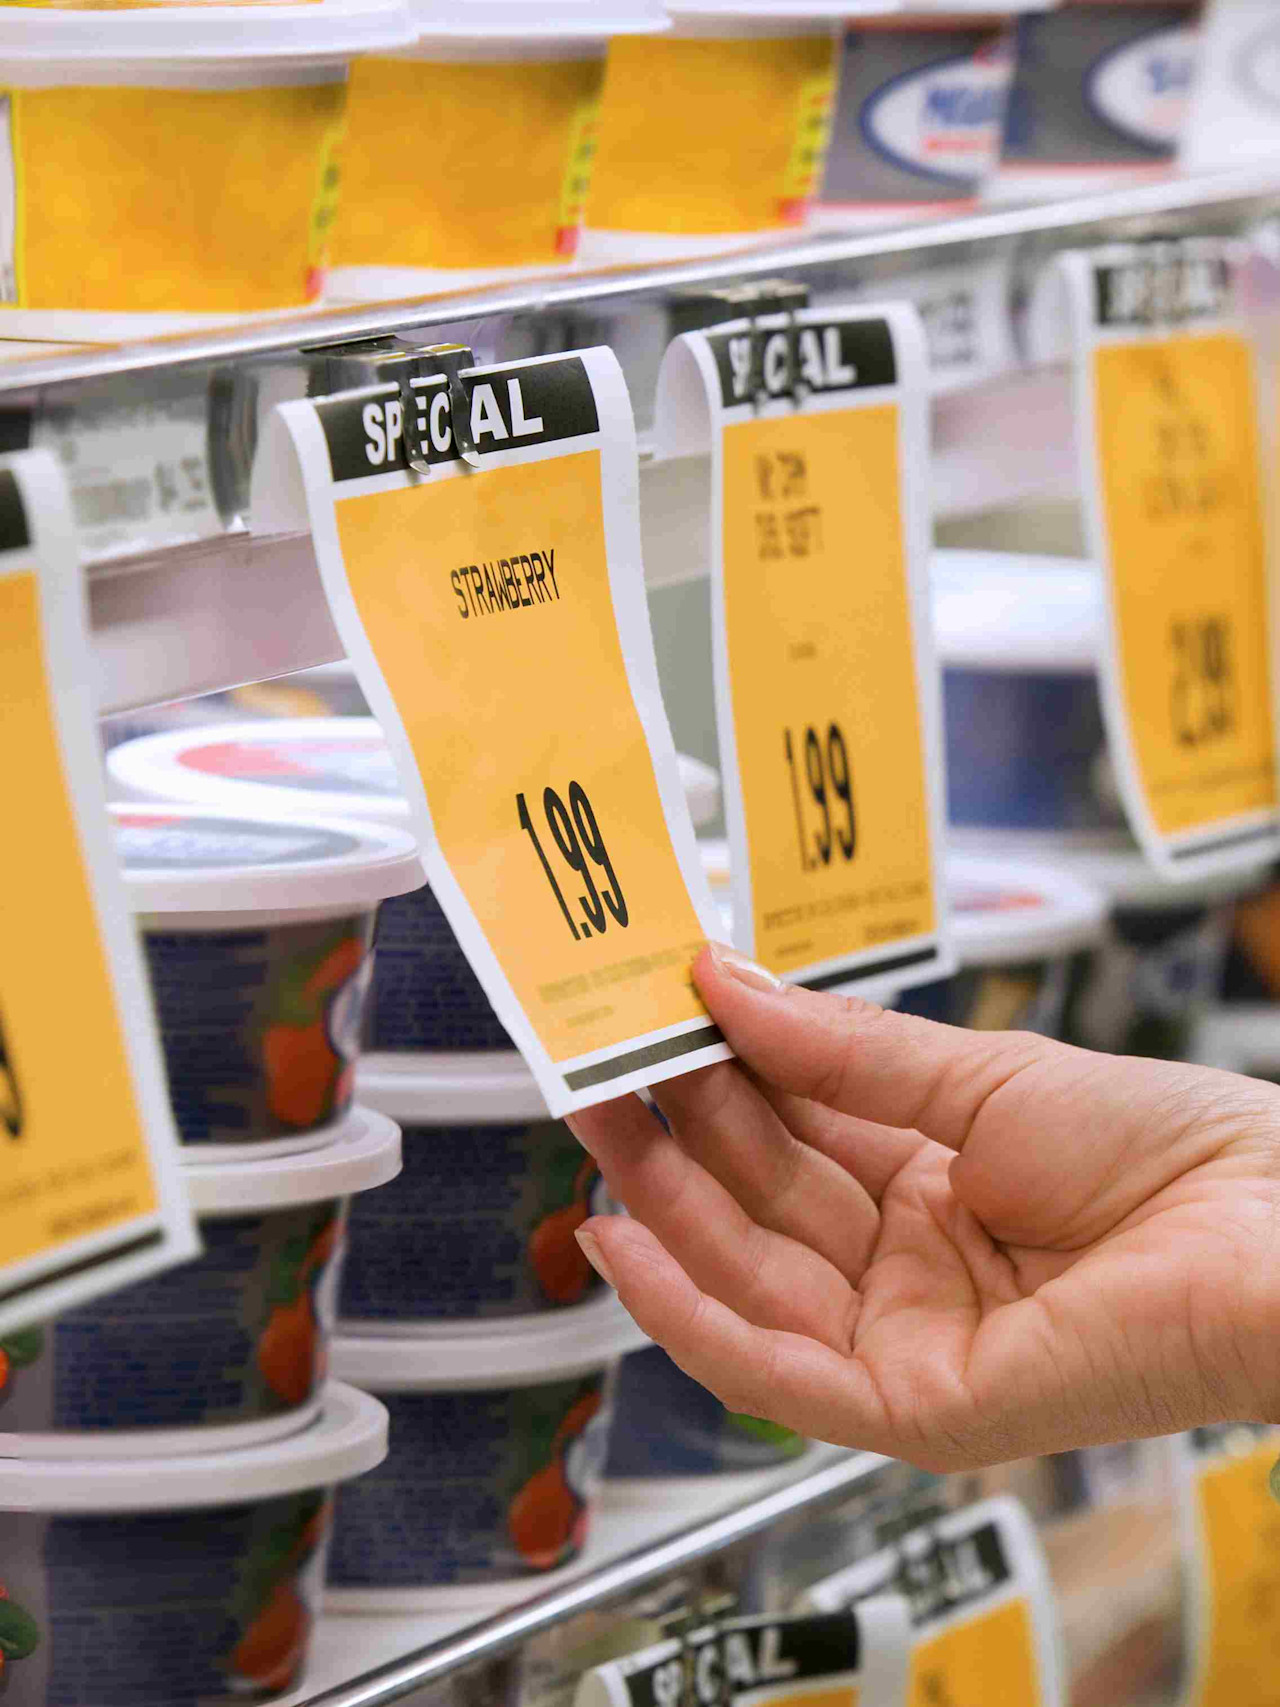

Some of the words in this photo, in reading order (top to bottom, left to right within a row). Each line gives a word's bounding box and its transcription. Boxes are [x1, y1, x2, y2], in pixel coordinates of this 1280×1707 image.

[728, 326, 857, 398] SCAL
[362, 378, 544, 466] SPECAL
[450, 549, 560, 619] STRAWBERRY
[783, 722, 857, 873] 1.99
[516, 780, 629, 941] 1.99
